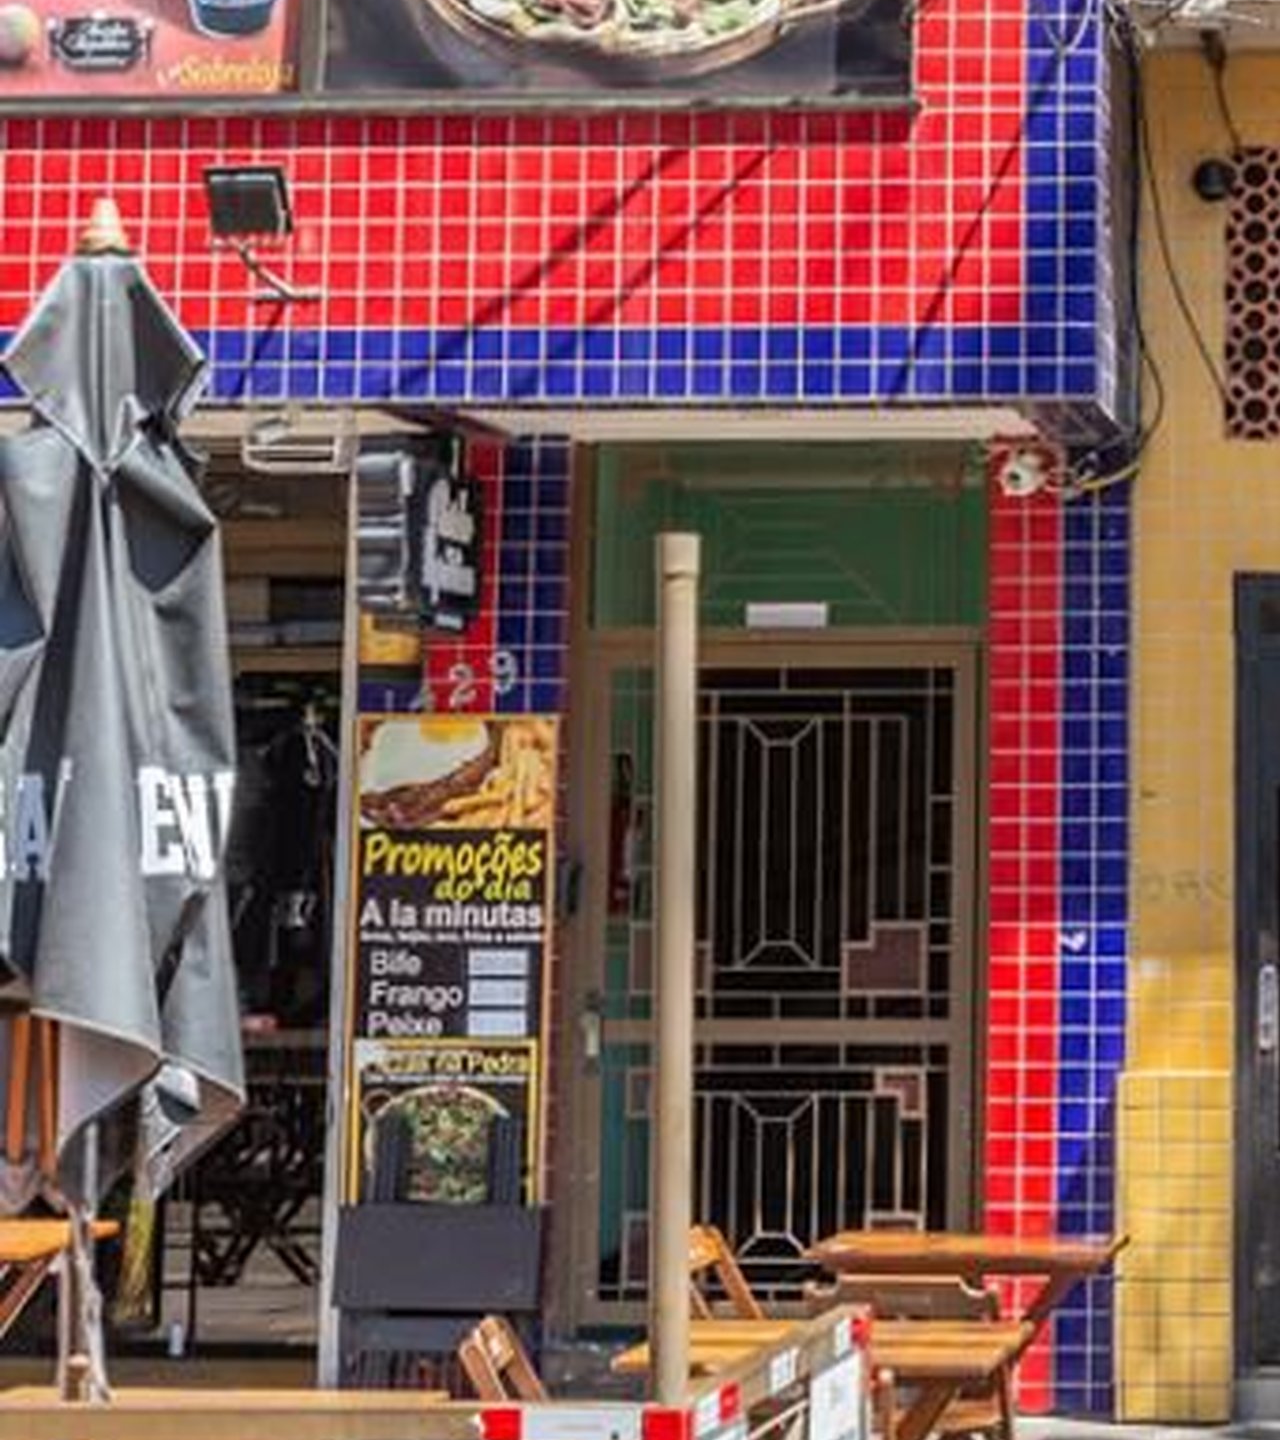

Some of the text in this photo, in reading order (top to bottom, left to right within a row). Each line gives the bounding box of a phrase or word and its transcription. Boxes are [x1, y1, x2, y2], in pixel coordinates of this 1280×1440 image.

[363, 830, 543, 888] Promoções
[434, 872, 534, 902] do dia
[360, 898, 543, 928] A la minutas
[370, 950, 422, 976] Bife
[369, 980, 463, 1012] Frango
[366, 1012, 443, 1037] Peixe
